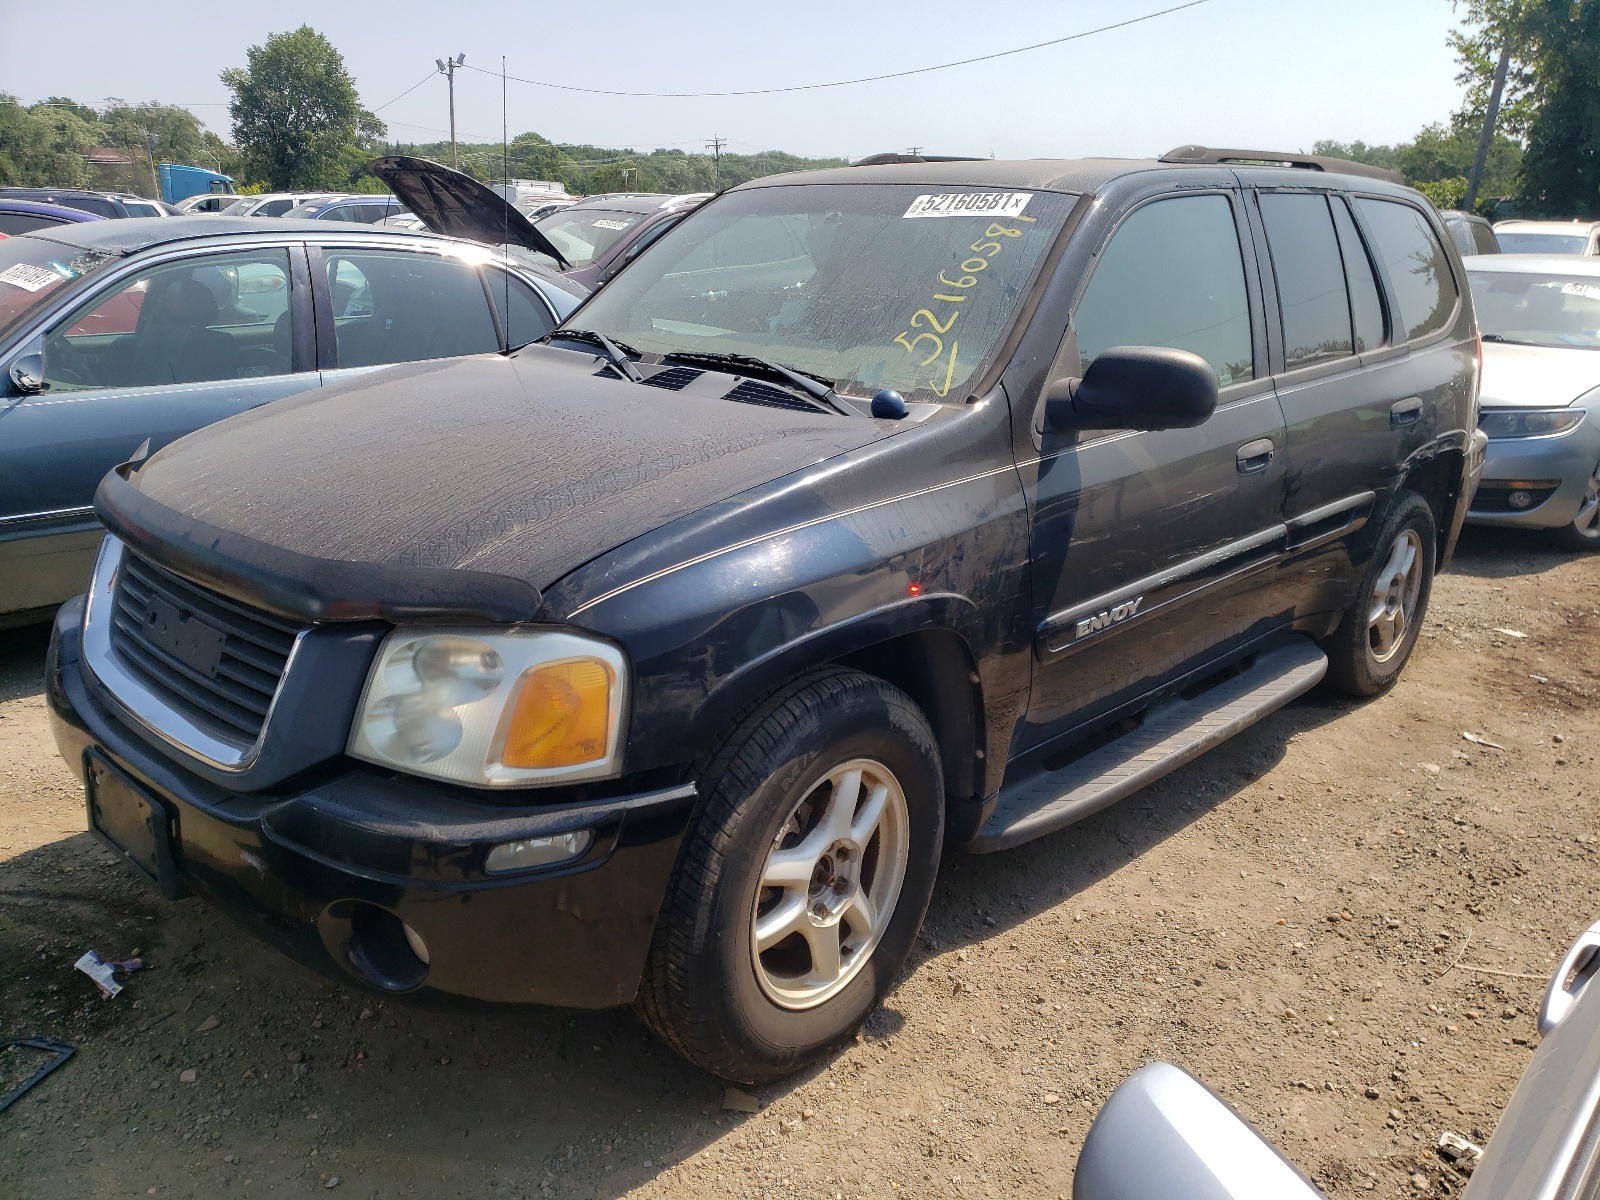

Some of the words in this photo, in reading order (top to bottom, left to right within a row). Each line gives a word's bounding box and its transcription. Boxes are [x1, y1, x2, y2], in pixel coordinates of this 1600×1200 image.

[921, 193, 1010, 211] 52160581
[894, 215, 1037, 367] 52160581
[1075, 596, 1143, 639] ENVOY
